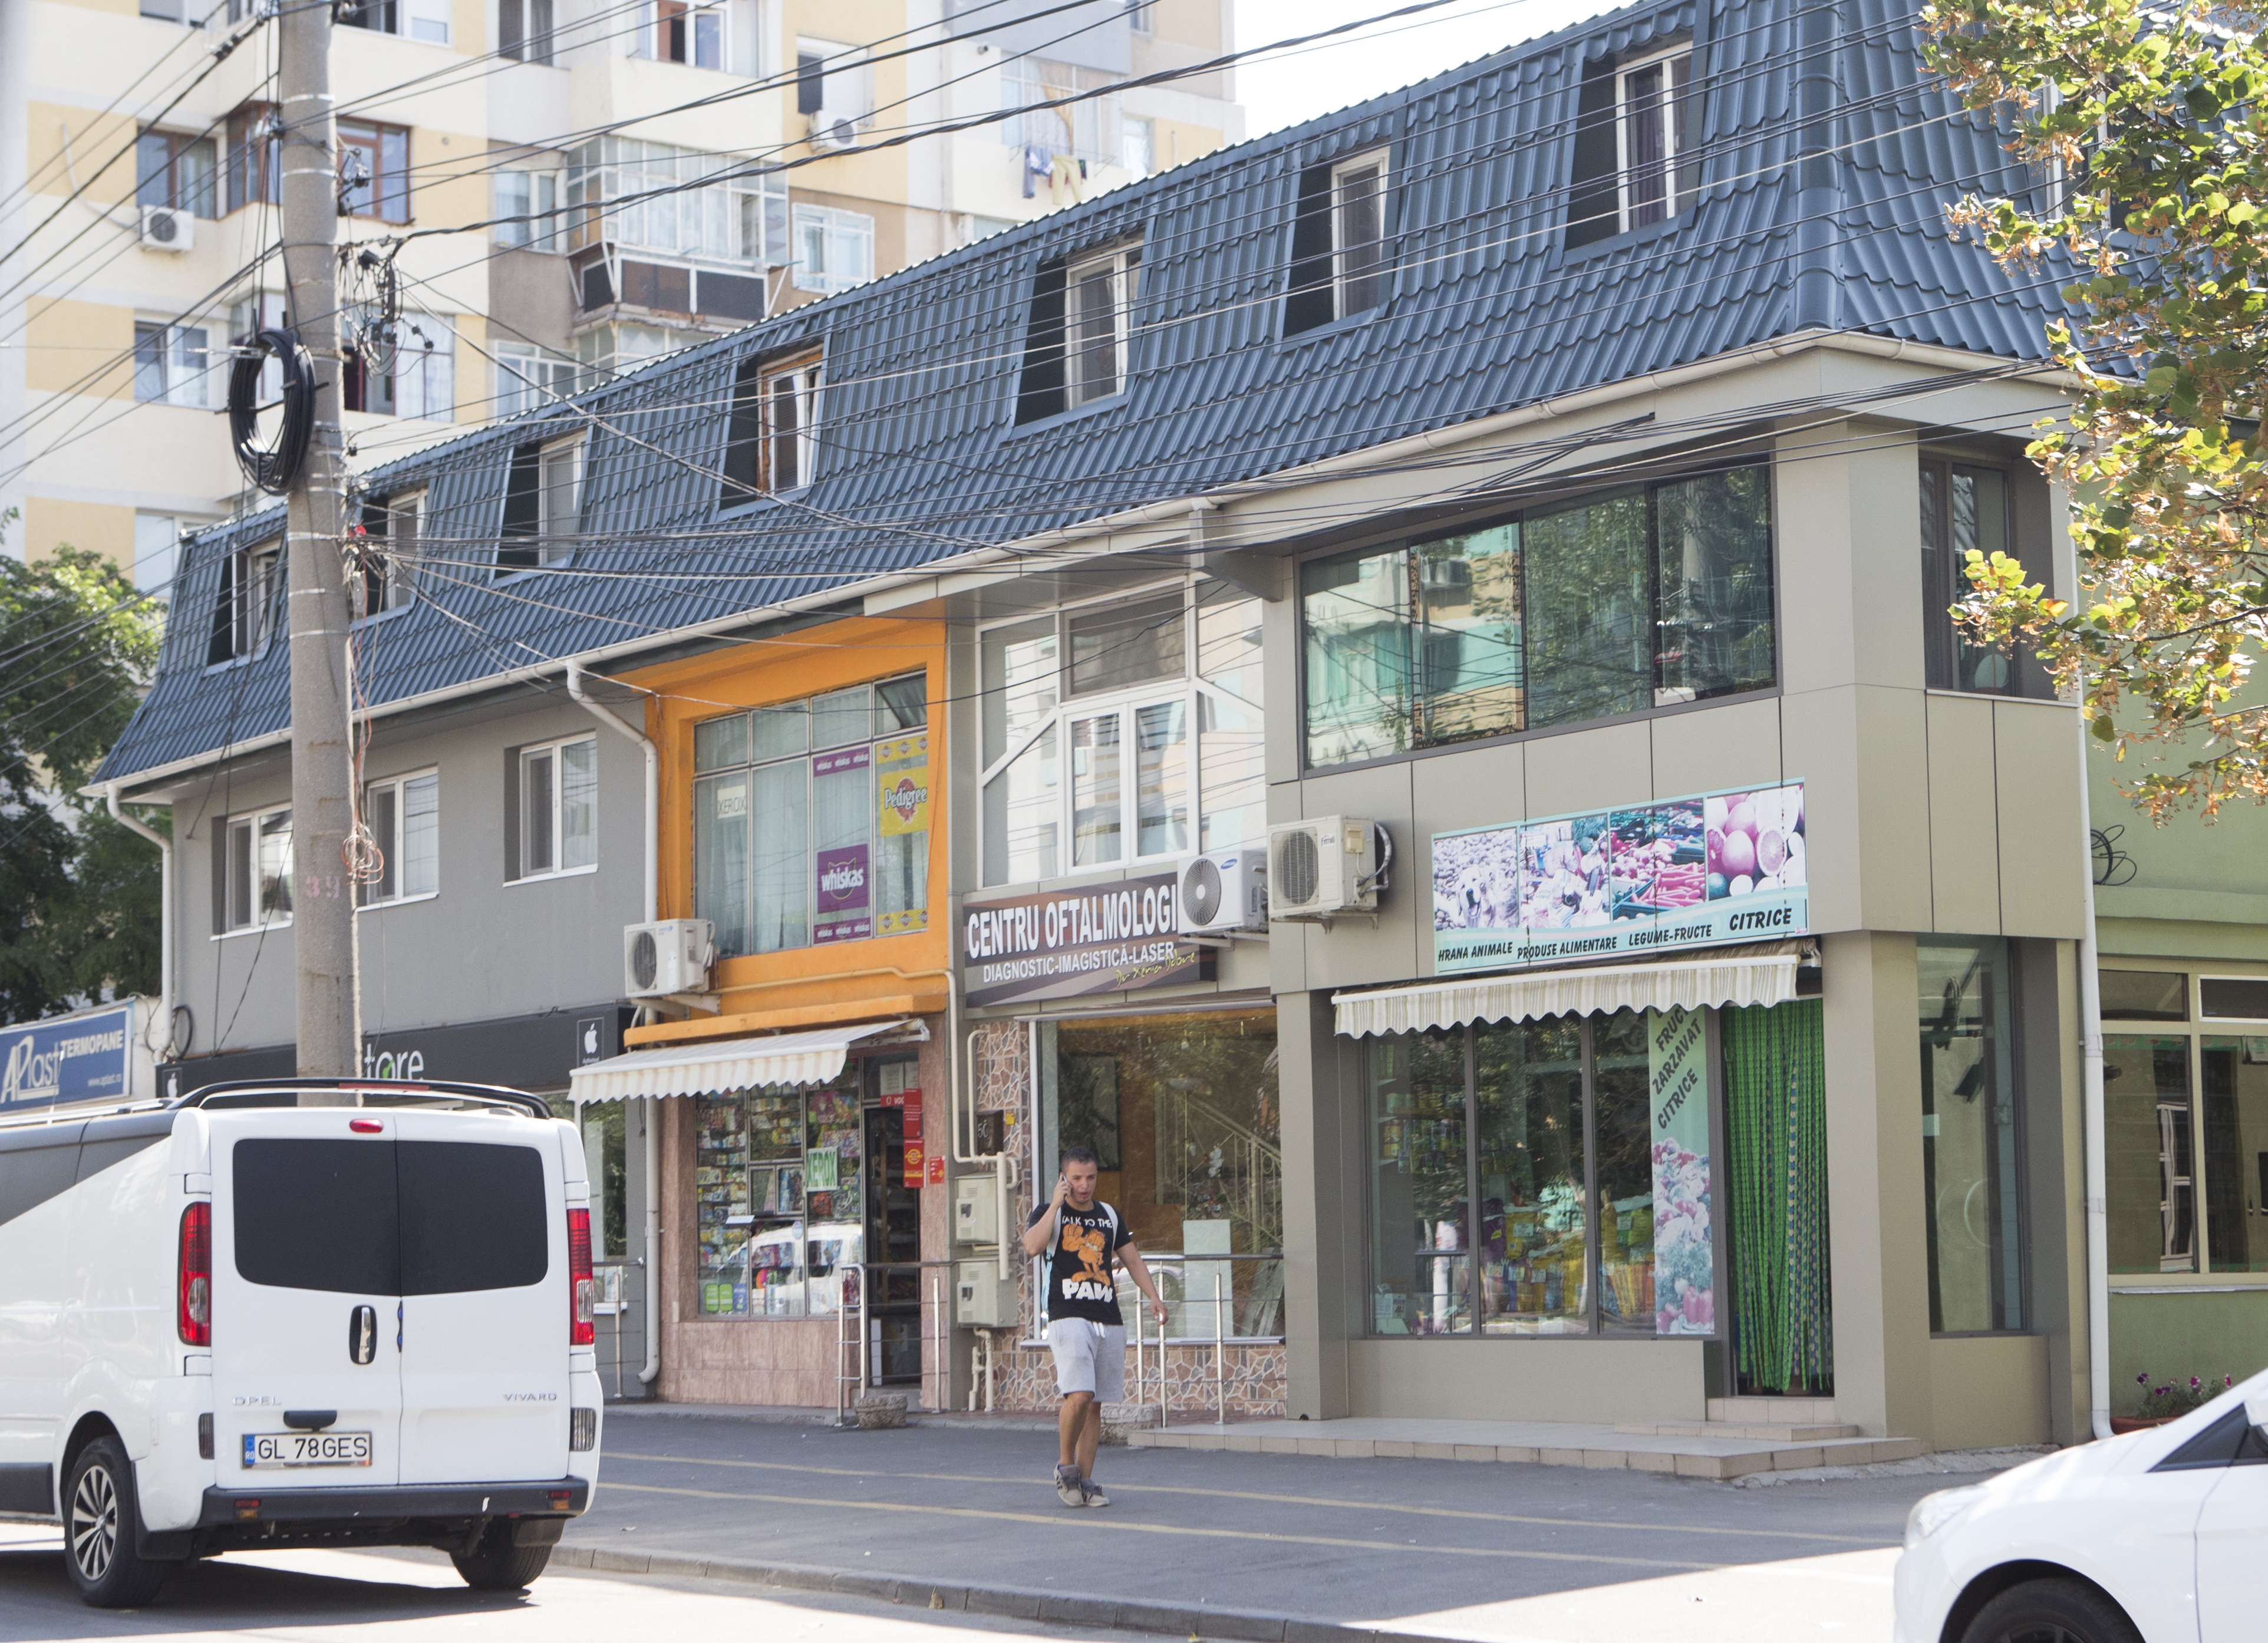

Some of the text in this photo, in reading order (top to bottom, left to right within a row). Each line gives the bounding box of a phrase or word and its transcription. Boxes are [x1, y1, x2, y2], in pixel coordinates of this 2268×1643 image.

[885, 787, 927, 810] Pedigree
[822, 867, 864, 892] whiskas
[967, 884, 1178, 959] CENTRU OFTALMOLOGI
[1729, 908, 1792, 931] CITRICE
[1629, 924, 1712, 946] LEGUME-FRUCTE
[1438, 941, 1513, 962] HRANA ANIMALE
[1517, 936, 1617, 959] PRODUSE ALIMENTARE
[983, 941, 1174, 984] DIAGNOSTIC-IMAGISTICĂ-LASER
[60, 1030, 124, 1058] TERMOPANE
[1652, 1017, 1702, 1095] ZARZAVAT
[364, 1043, 424, 1080] tore
[1657, 1068, 1698, 1129] CITRICE
[807, 1151, 836, 1188] XEROX
[1097, 1218, 1113, 1228] THE
[1062, 1278, 1113, 1303] PAW
[233, 1395, 282, 1406] OPEL
[503, 1393, 557, 1401] VIVARO
[259, 1439, 285, 1459] GL
